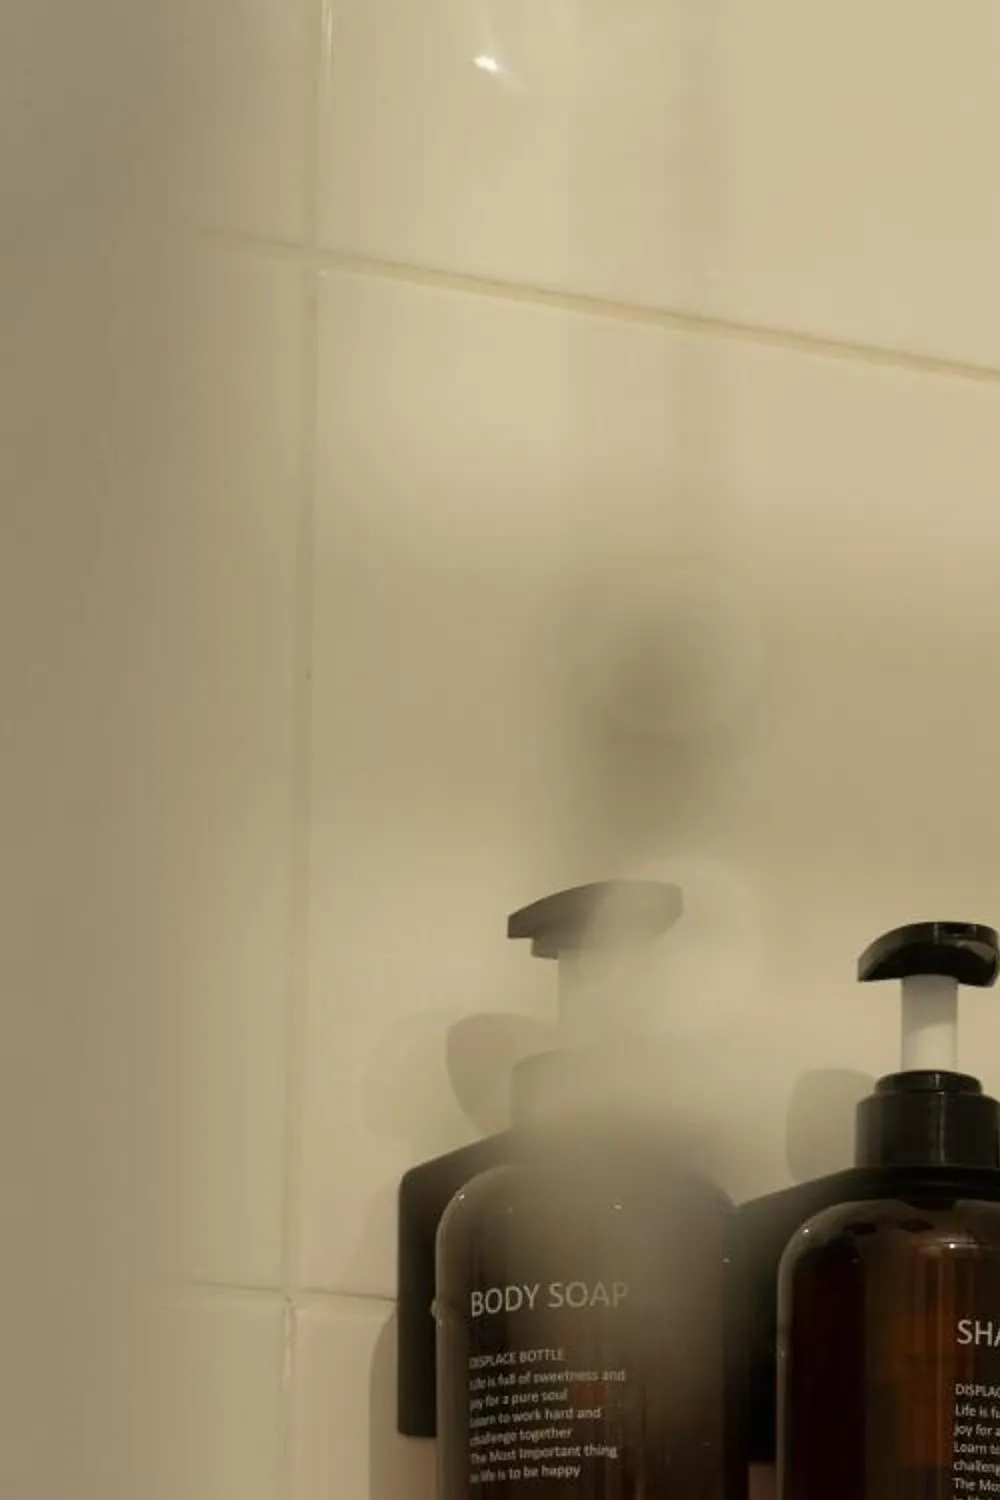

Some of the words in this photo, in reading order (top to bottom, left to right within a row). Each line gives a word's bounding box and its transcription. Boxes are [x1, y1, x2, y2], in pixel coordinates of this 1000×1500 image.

[471, 1282, 540, 1317] BODY
[547, 1281, 629, 1308] SOAP
[469, 1352, 516, 1369] DISPLACE
[519, 1349, 567, 1362] BOTTLE
[518, 1371, 531, 1384] of
[600, 1369, 626, 1382] and
[485, 1395, 499, 1407] for
[511, 1392, 539, 1405] pure
[542, 1388, 568, 1401] soul
[499, 1412, 511, 1424] to
[512, 1409, 541, 1422] work
[545, 1407, 573, 1420] hard
[576, 1407, 601, 1419] and
[955, 1404, 977, 1417] Life
[519, 1428, 572, 1443] together
[975, 1423, 992, 1436] for
[995, 1427, 1000, 1437] a
[954, 1441, 987, 1453] Learn
[509, 1466, 521, 1479] to
[523, 1465, 539, 1478] be
[541, 1464, 581, 1479] happy
[953, 1477, 976, 1490] The
